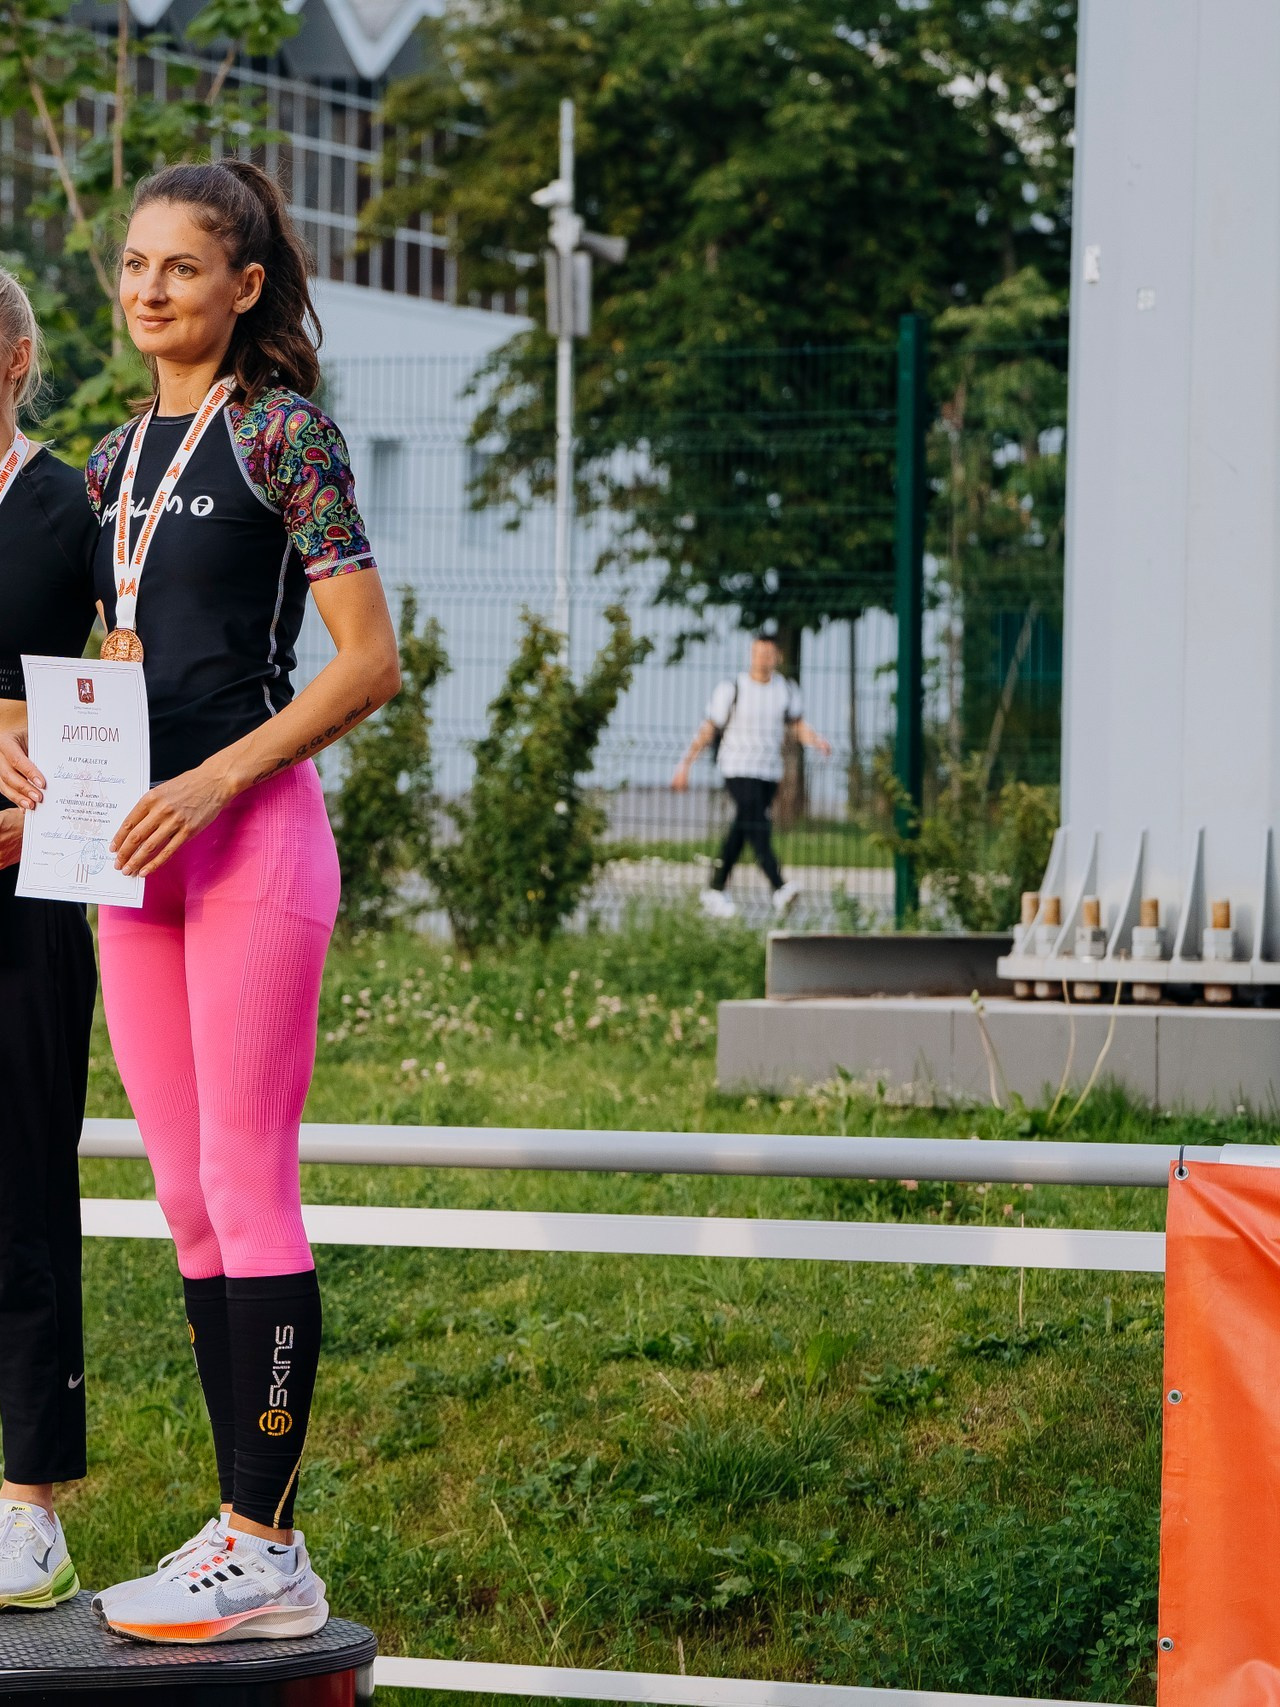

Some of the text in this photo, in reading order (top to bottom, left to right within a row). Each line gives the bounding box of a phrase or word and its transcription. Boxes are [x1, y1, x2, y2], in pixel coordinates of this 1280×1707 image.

[183, 405, 214, 452] МОСКОВСКИЙ
[6, 450, 20, 473] СПОРТ
[117, 491, 129, 565] МОСКОВСКИЙ СПОРТ
[135, 490, 168, 565] МОСКОВСКИЙ СПОРТ
[62, 724, 120, 743] ДИПЛОМ
